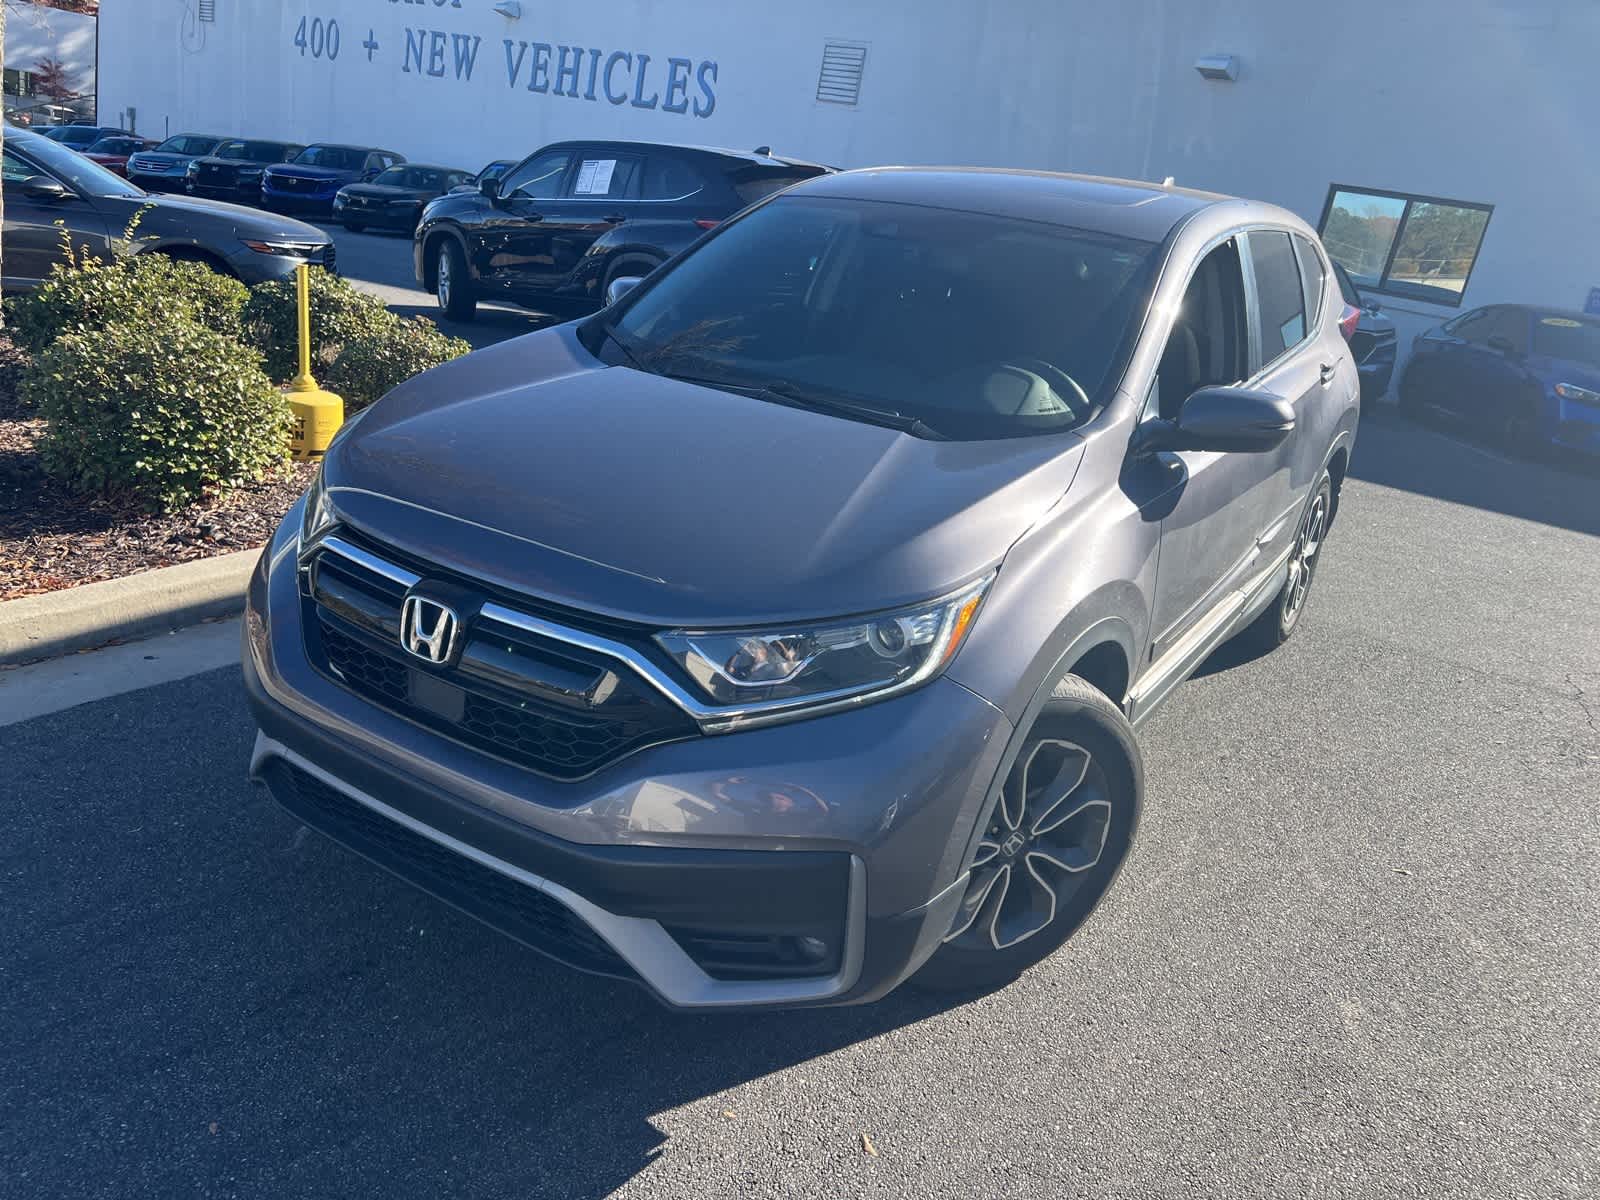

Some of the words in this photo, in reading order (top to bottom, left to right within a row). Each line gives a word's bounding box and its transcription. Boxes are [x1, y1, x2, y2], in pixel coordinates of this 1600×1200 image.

[294, 15, 340, 61] 400
[363, 28, 379, 62] +
[402, 27, 480, 81] NEW
[502, 38, 718, 119] VEHICLES
